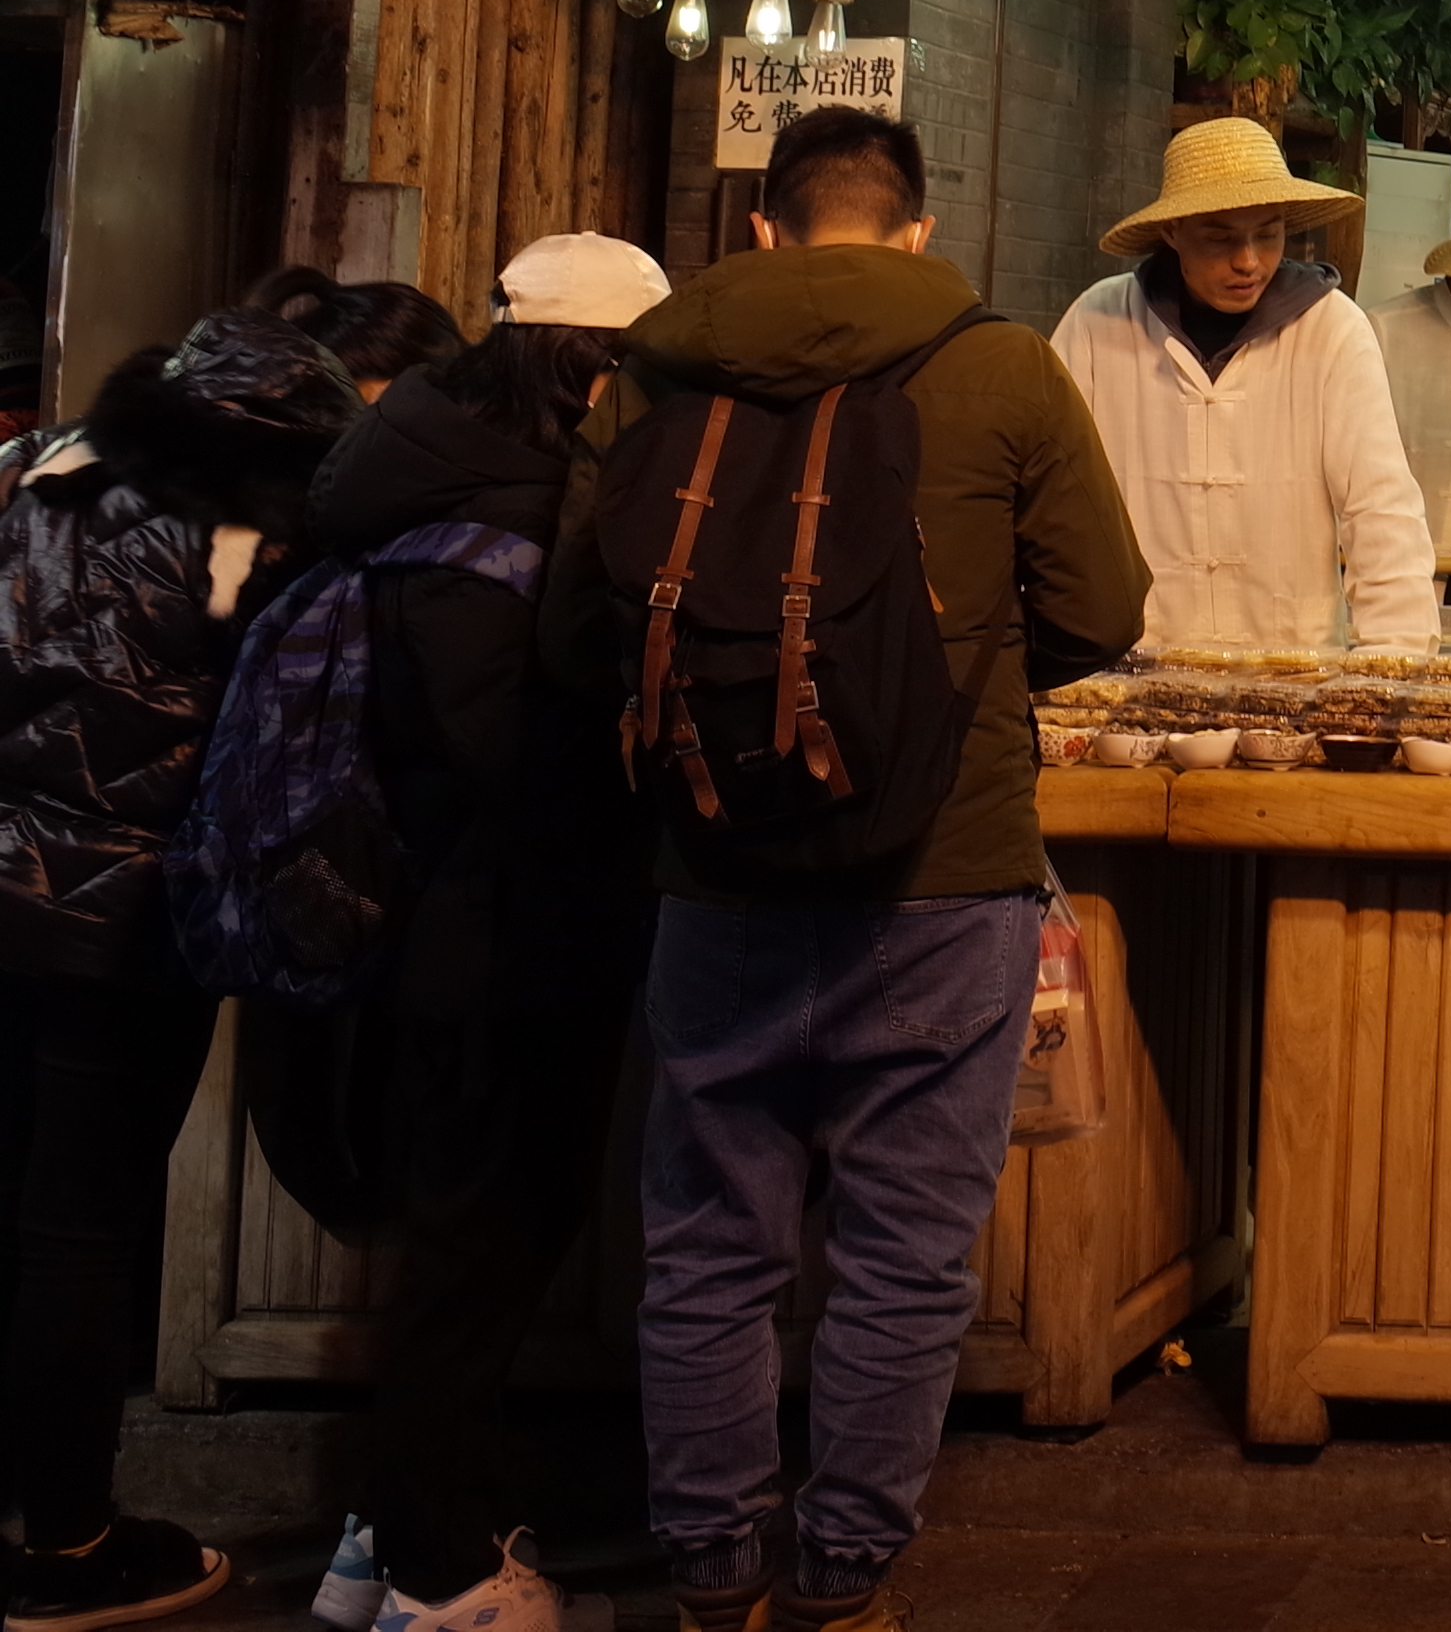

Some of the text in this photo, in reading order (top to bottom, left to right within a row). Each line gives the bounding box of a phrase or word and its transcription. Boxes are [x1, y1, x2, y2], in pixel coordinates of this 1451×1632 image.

[726, 55, 896, 98] 凡在本店消费
